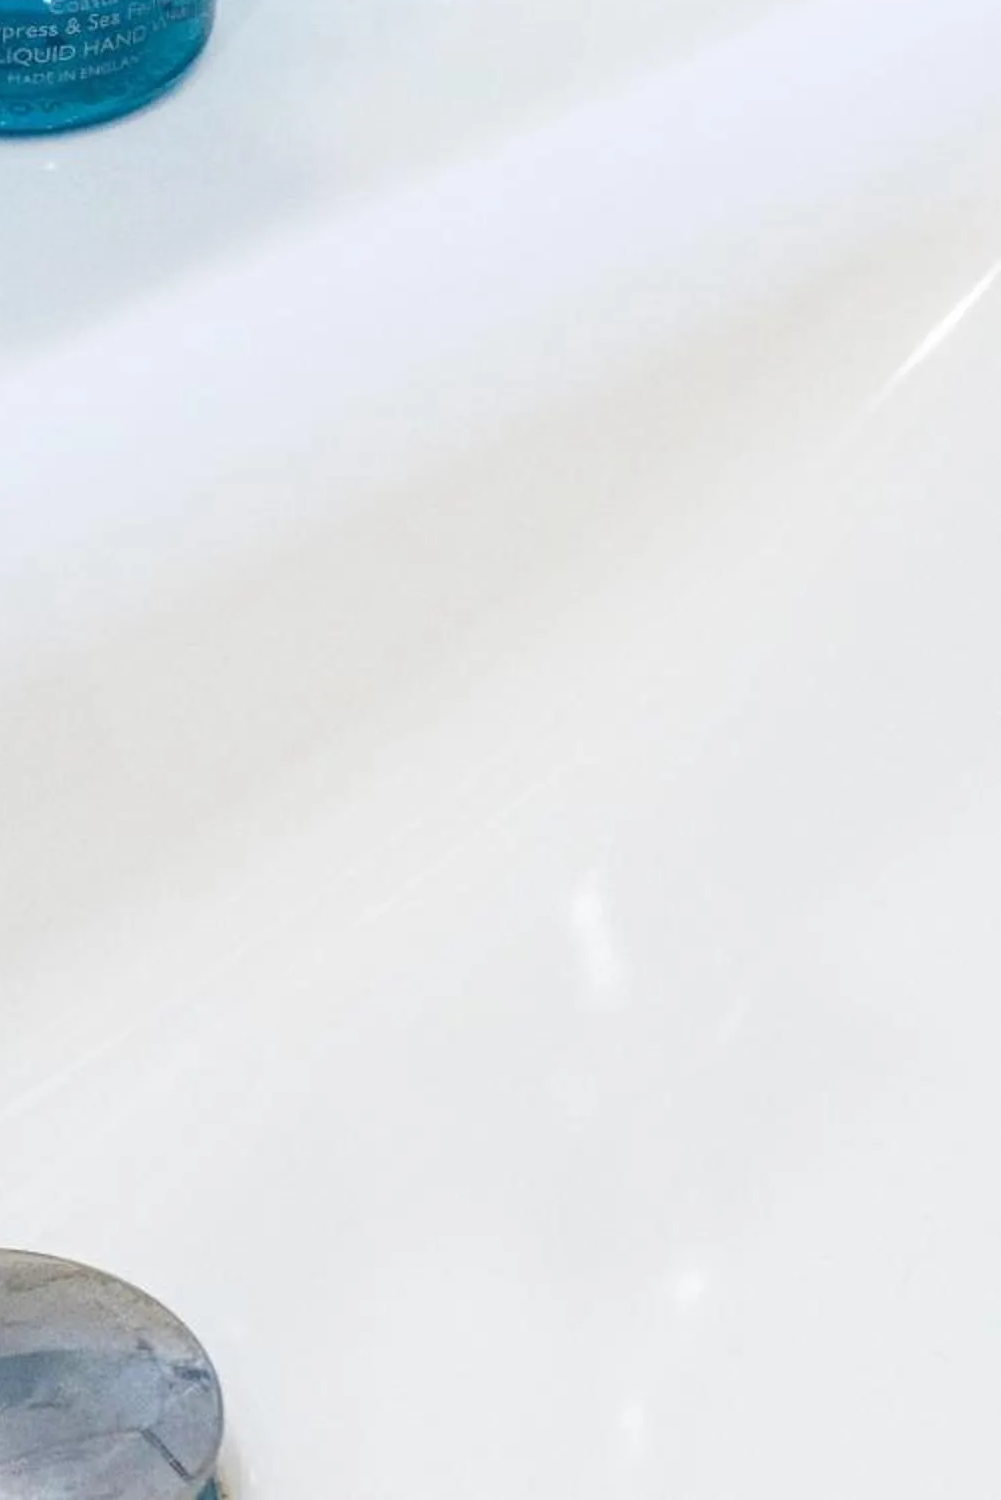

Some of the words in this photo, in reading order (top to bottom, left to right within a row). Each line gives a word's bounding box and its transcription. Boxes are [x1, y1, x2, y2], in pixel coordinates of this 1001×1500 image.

[64, 16, 82, 37] &
[87, 11, 121, 32] Sea
[83, 25, 148, 59] HAND
